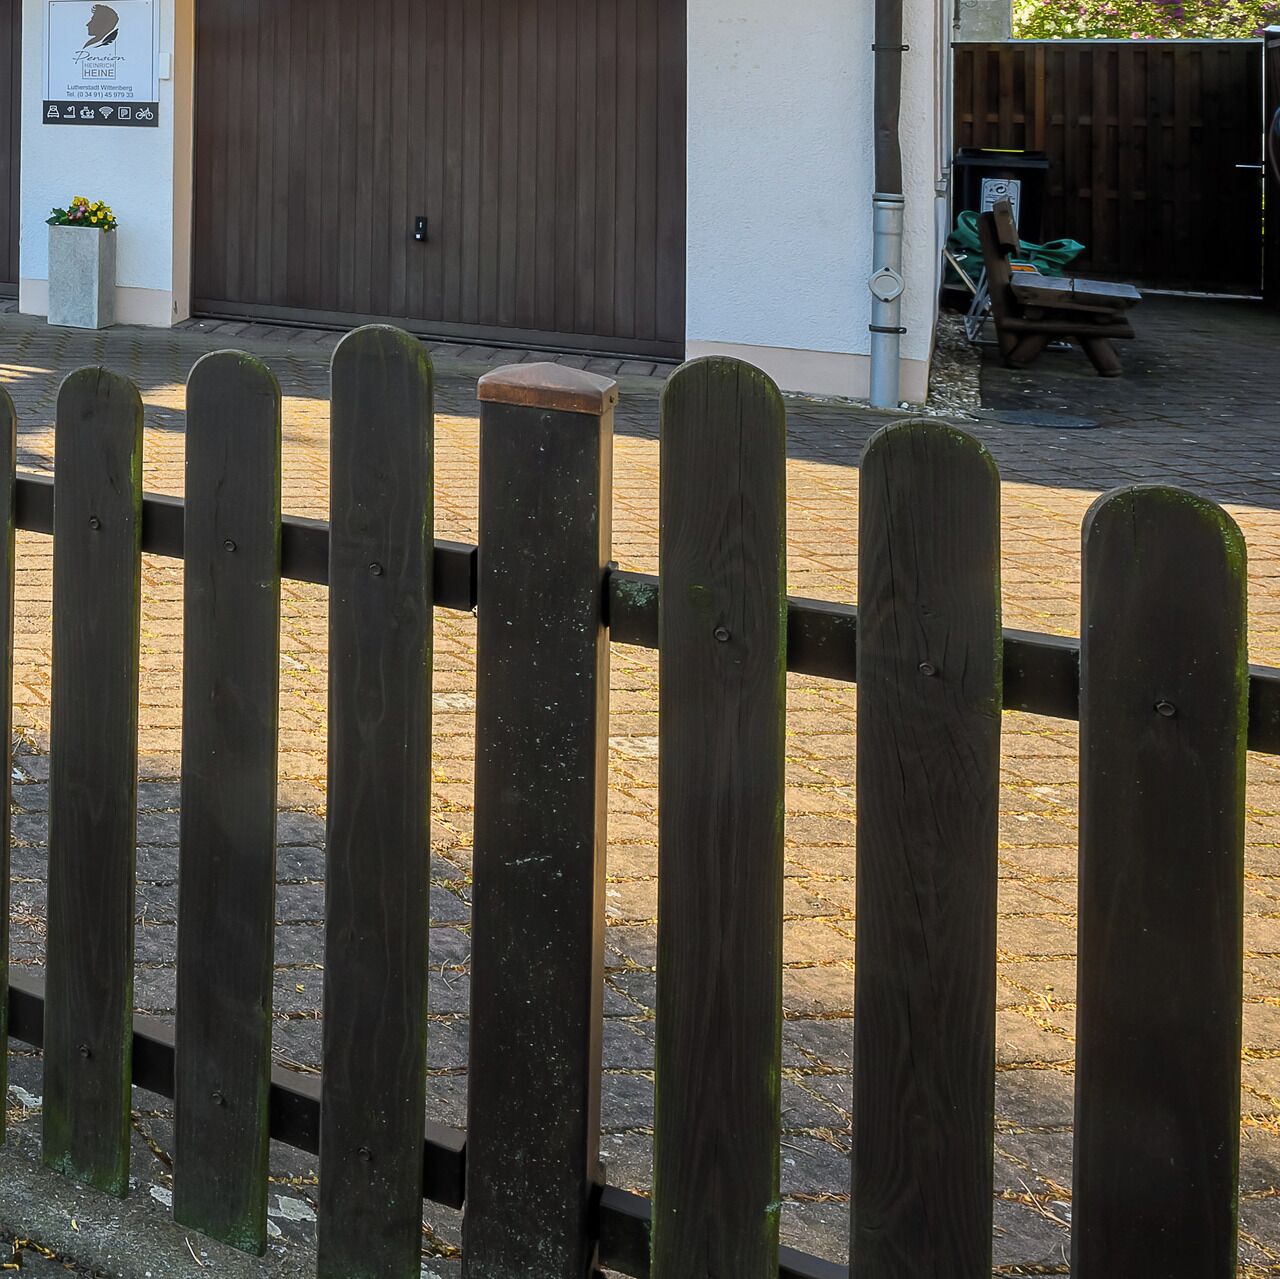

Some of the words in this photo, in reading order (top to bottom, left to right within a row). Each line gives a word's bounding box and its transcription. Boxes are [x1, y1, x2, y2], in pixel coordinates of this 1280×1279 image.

[72, 50, 126, 65] Pension
[84, 69, 114, 77] HEINE
[100, 84, 133, 92] Wittenberg
